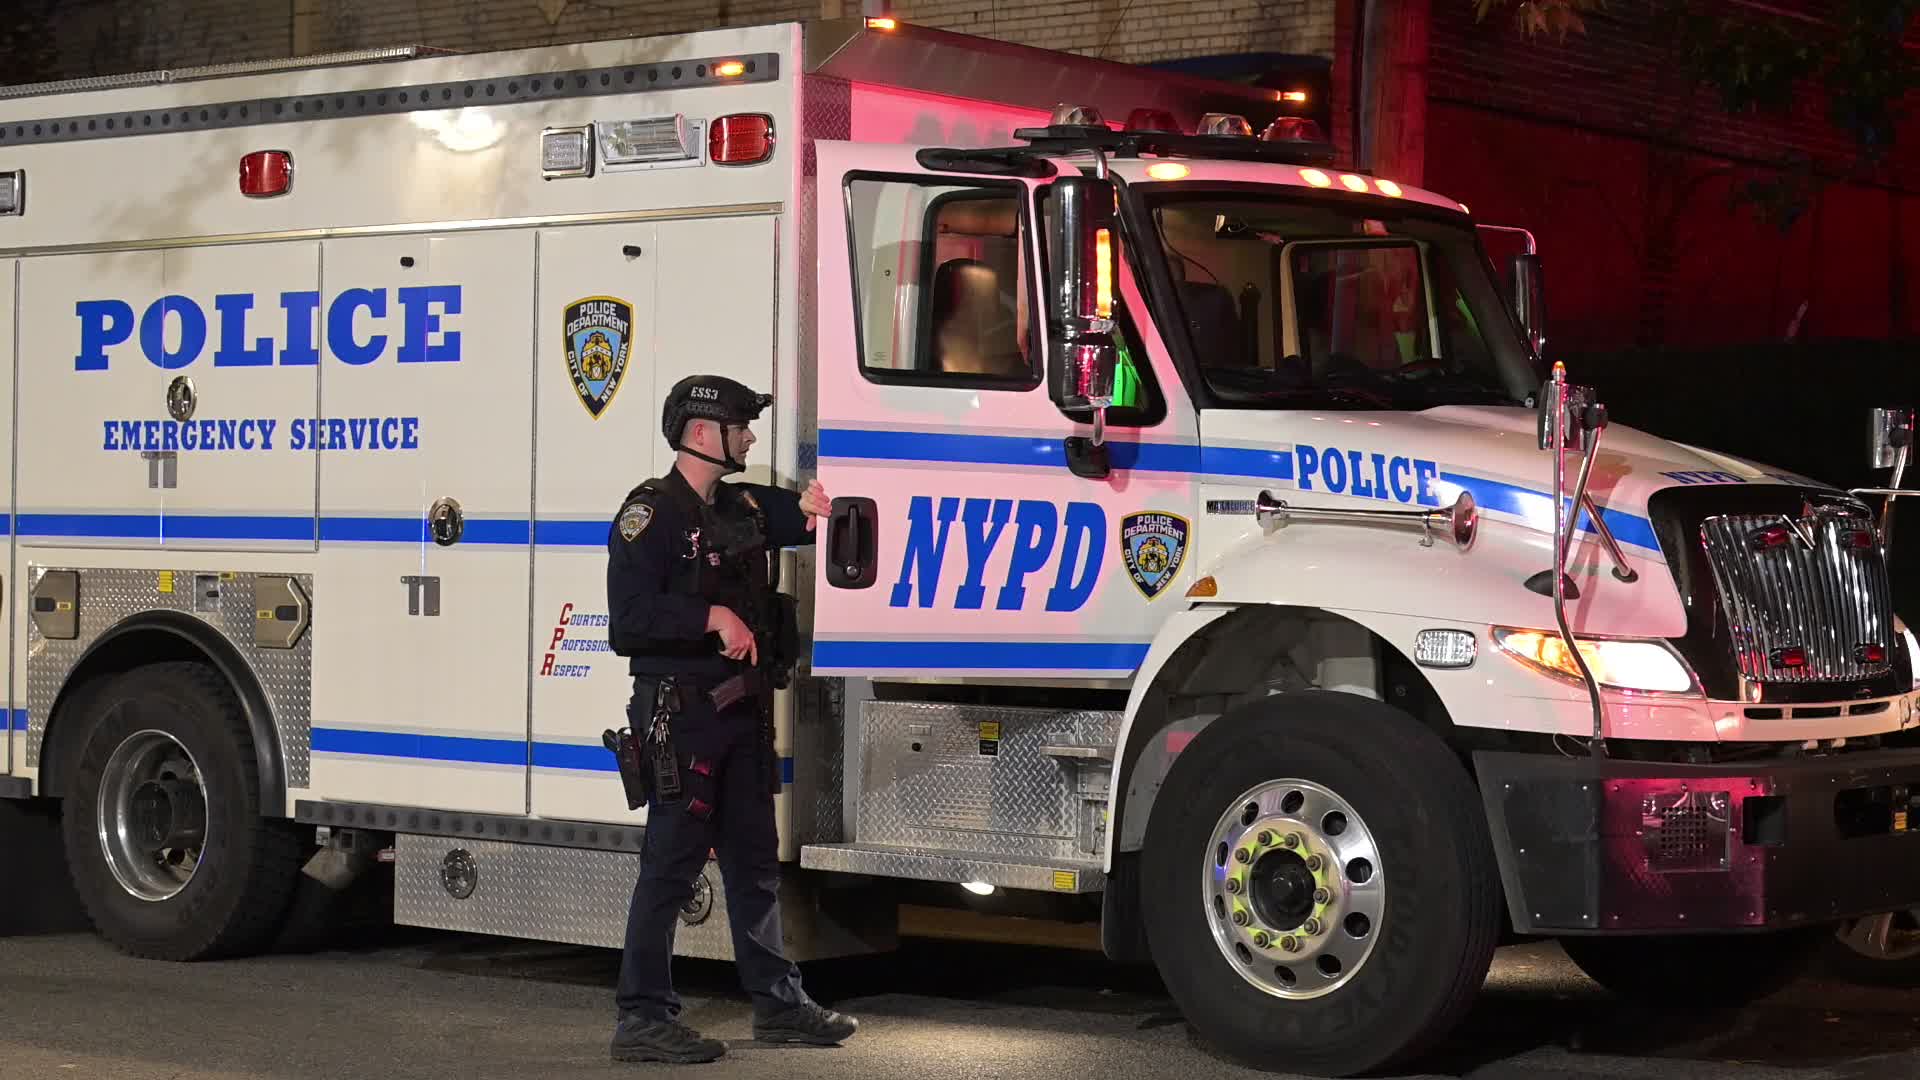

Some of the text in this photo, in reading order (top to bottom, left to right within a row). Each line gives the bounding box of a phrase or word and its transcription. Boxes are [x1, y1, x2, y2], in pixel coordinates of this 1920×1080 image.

[580, 302, 616, 316] POLICE
[75, 285, 461, 370] POLICE
[567, 314, 628, 336] DEPARTMENT
[568, 342, 628, 402] CITY OF NEW YORK
[691, 386, 718, 400] ESS3
[103, 417, 418, 450] EMERGENCY SERVICE
[1295, 444, 1439, 507] POLICE
[1124, 524, 1184, 541] DEPARTMENT
[1137, 515, 1173, 527] POLICE
[889, 496, 1107, 612] NYPD
[1124, 546, 1184, 590] CITY OF NEW YORK
[559, 603, 609, 627] COURTES
[540, 653, 591, 677] RESPECT
